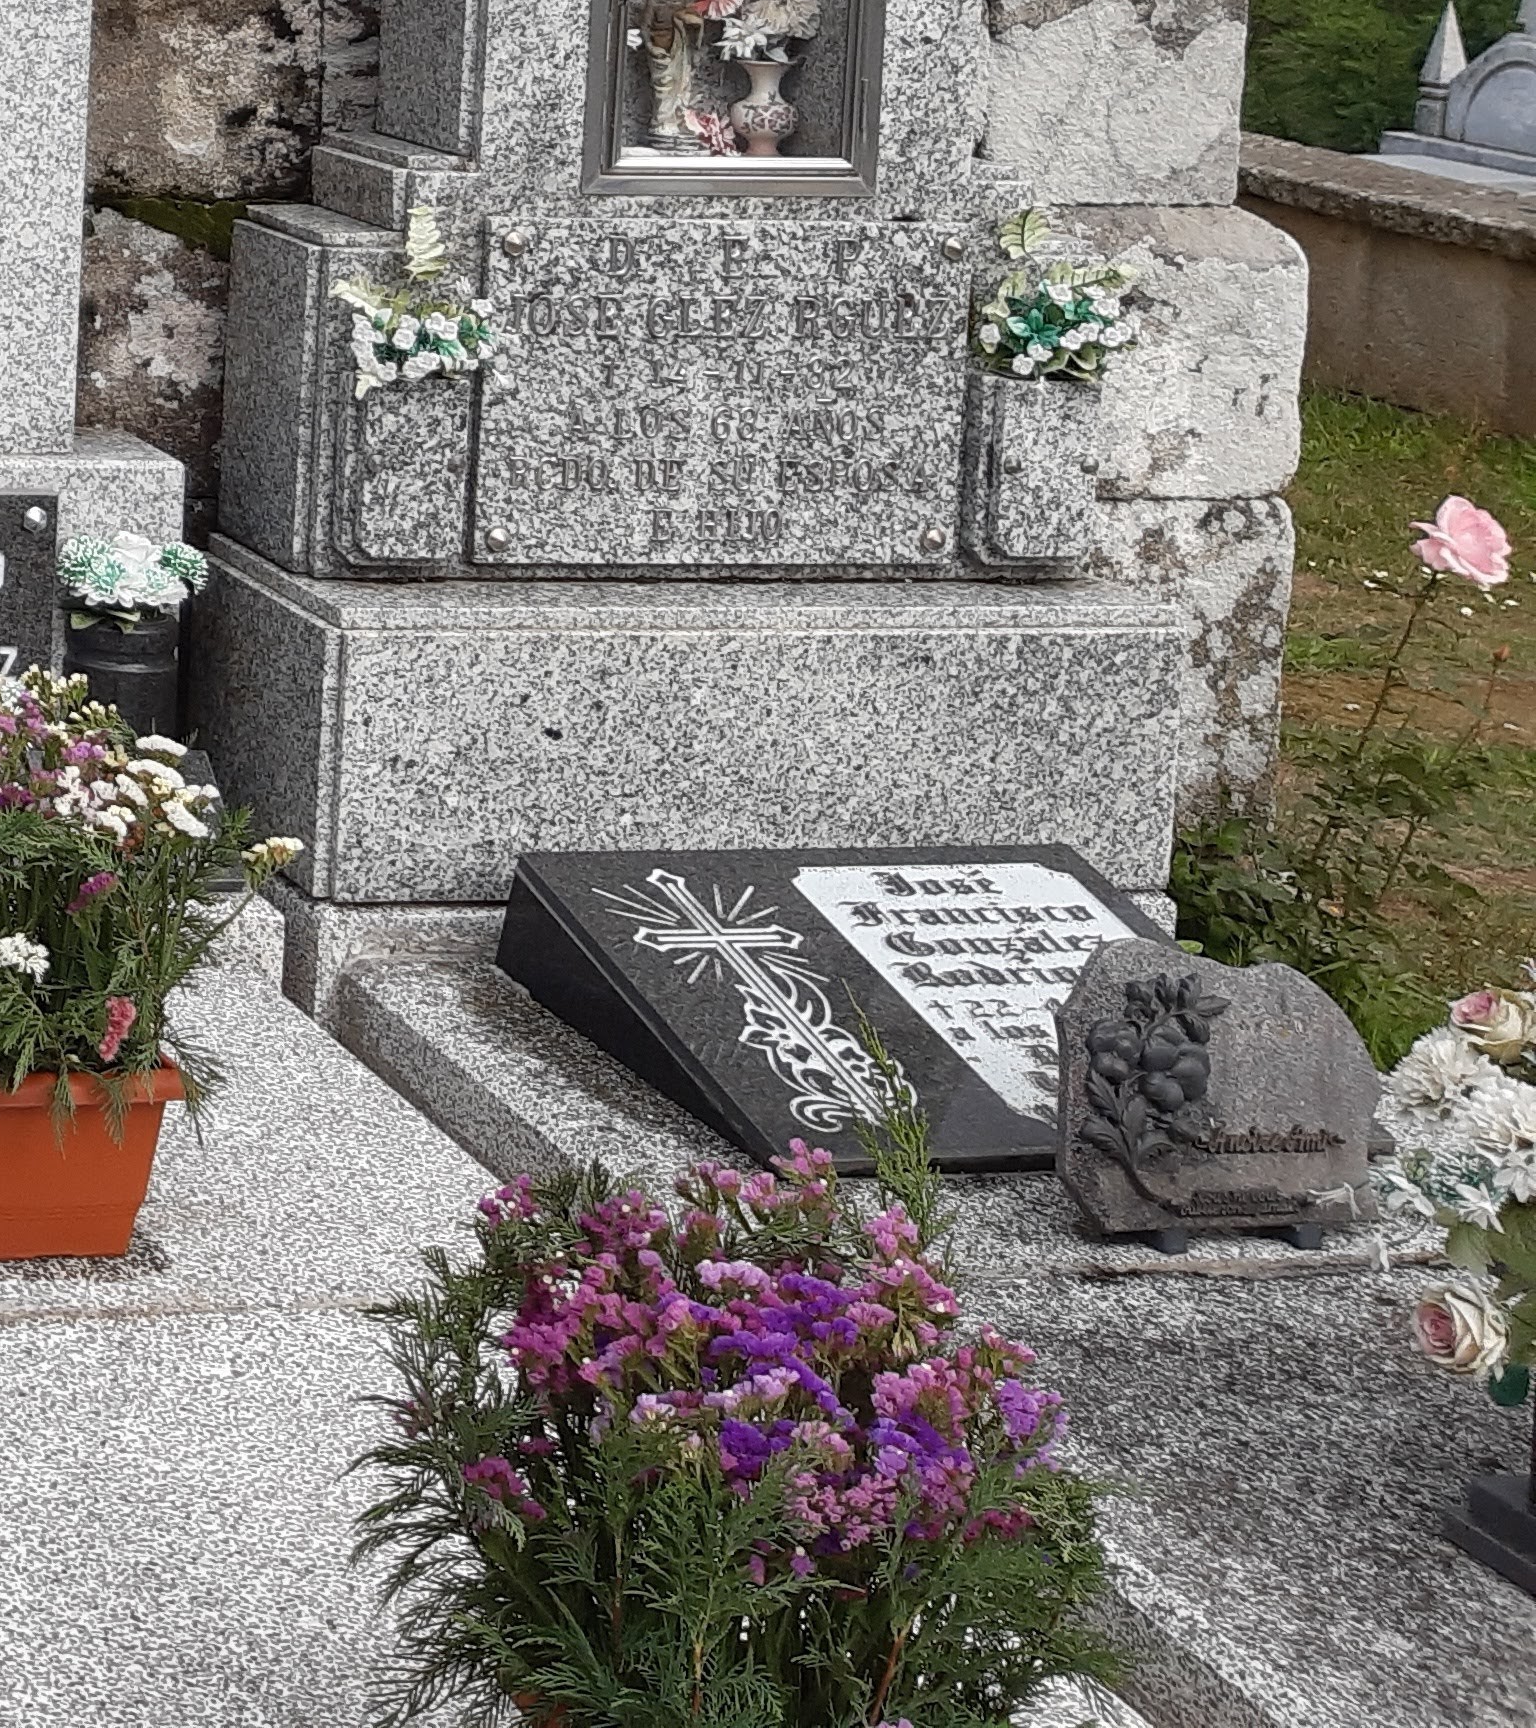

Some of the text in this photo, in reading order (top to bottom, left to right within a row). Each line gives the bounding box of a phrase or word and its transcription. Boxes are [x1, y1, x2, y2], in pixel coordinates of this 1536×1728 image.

[504, 293, 953, 340] JOSE GLEZ RGUEZ
[634, 458, 685, 492] DE
[778, 459, 932, 492] ESPOSA
[697, 509, 783, 542] HIJO
[870, 869, 1004, 897] José
[836, 900, 1099, 928] Francisco
[884, 926, 1103, 965] González
